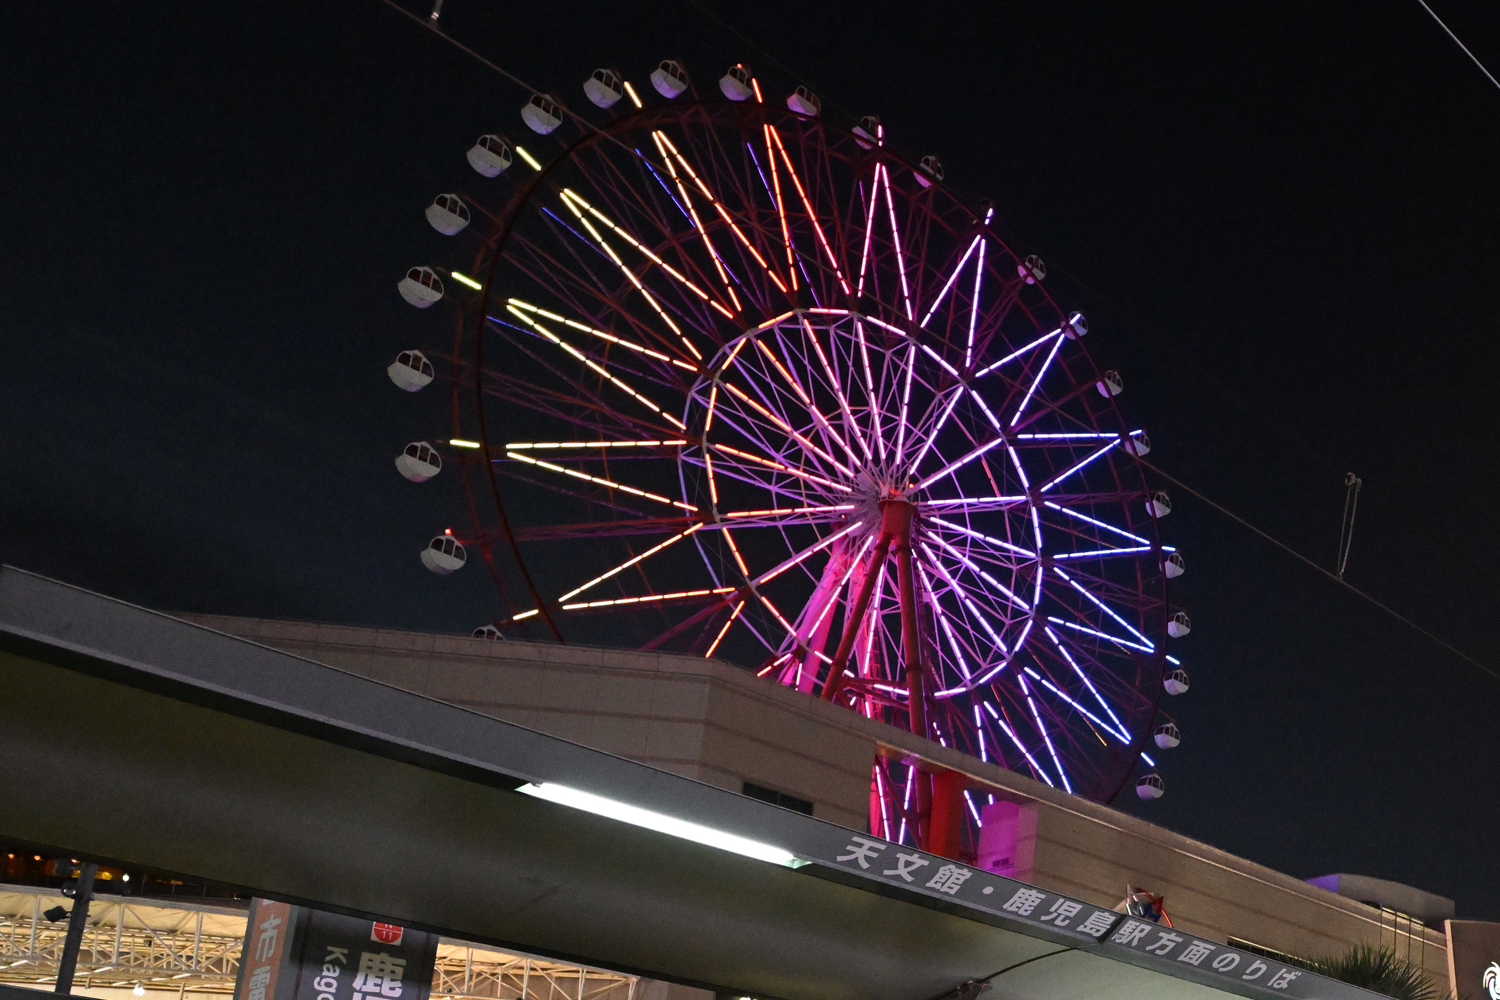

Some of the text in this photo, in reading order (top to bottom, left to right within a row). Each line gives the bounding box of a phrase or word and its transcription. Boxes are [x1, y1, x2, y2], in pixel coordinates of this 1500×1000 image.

[382, 931, 393, 941] 11
[836, 835, 1301, 991] 天文館・鹿児島駅方面のりば
